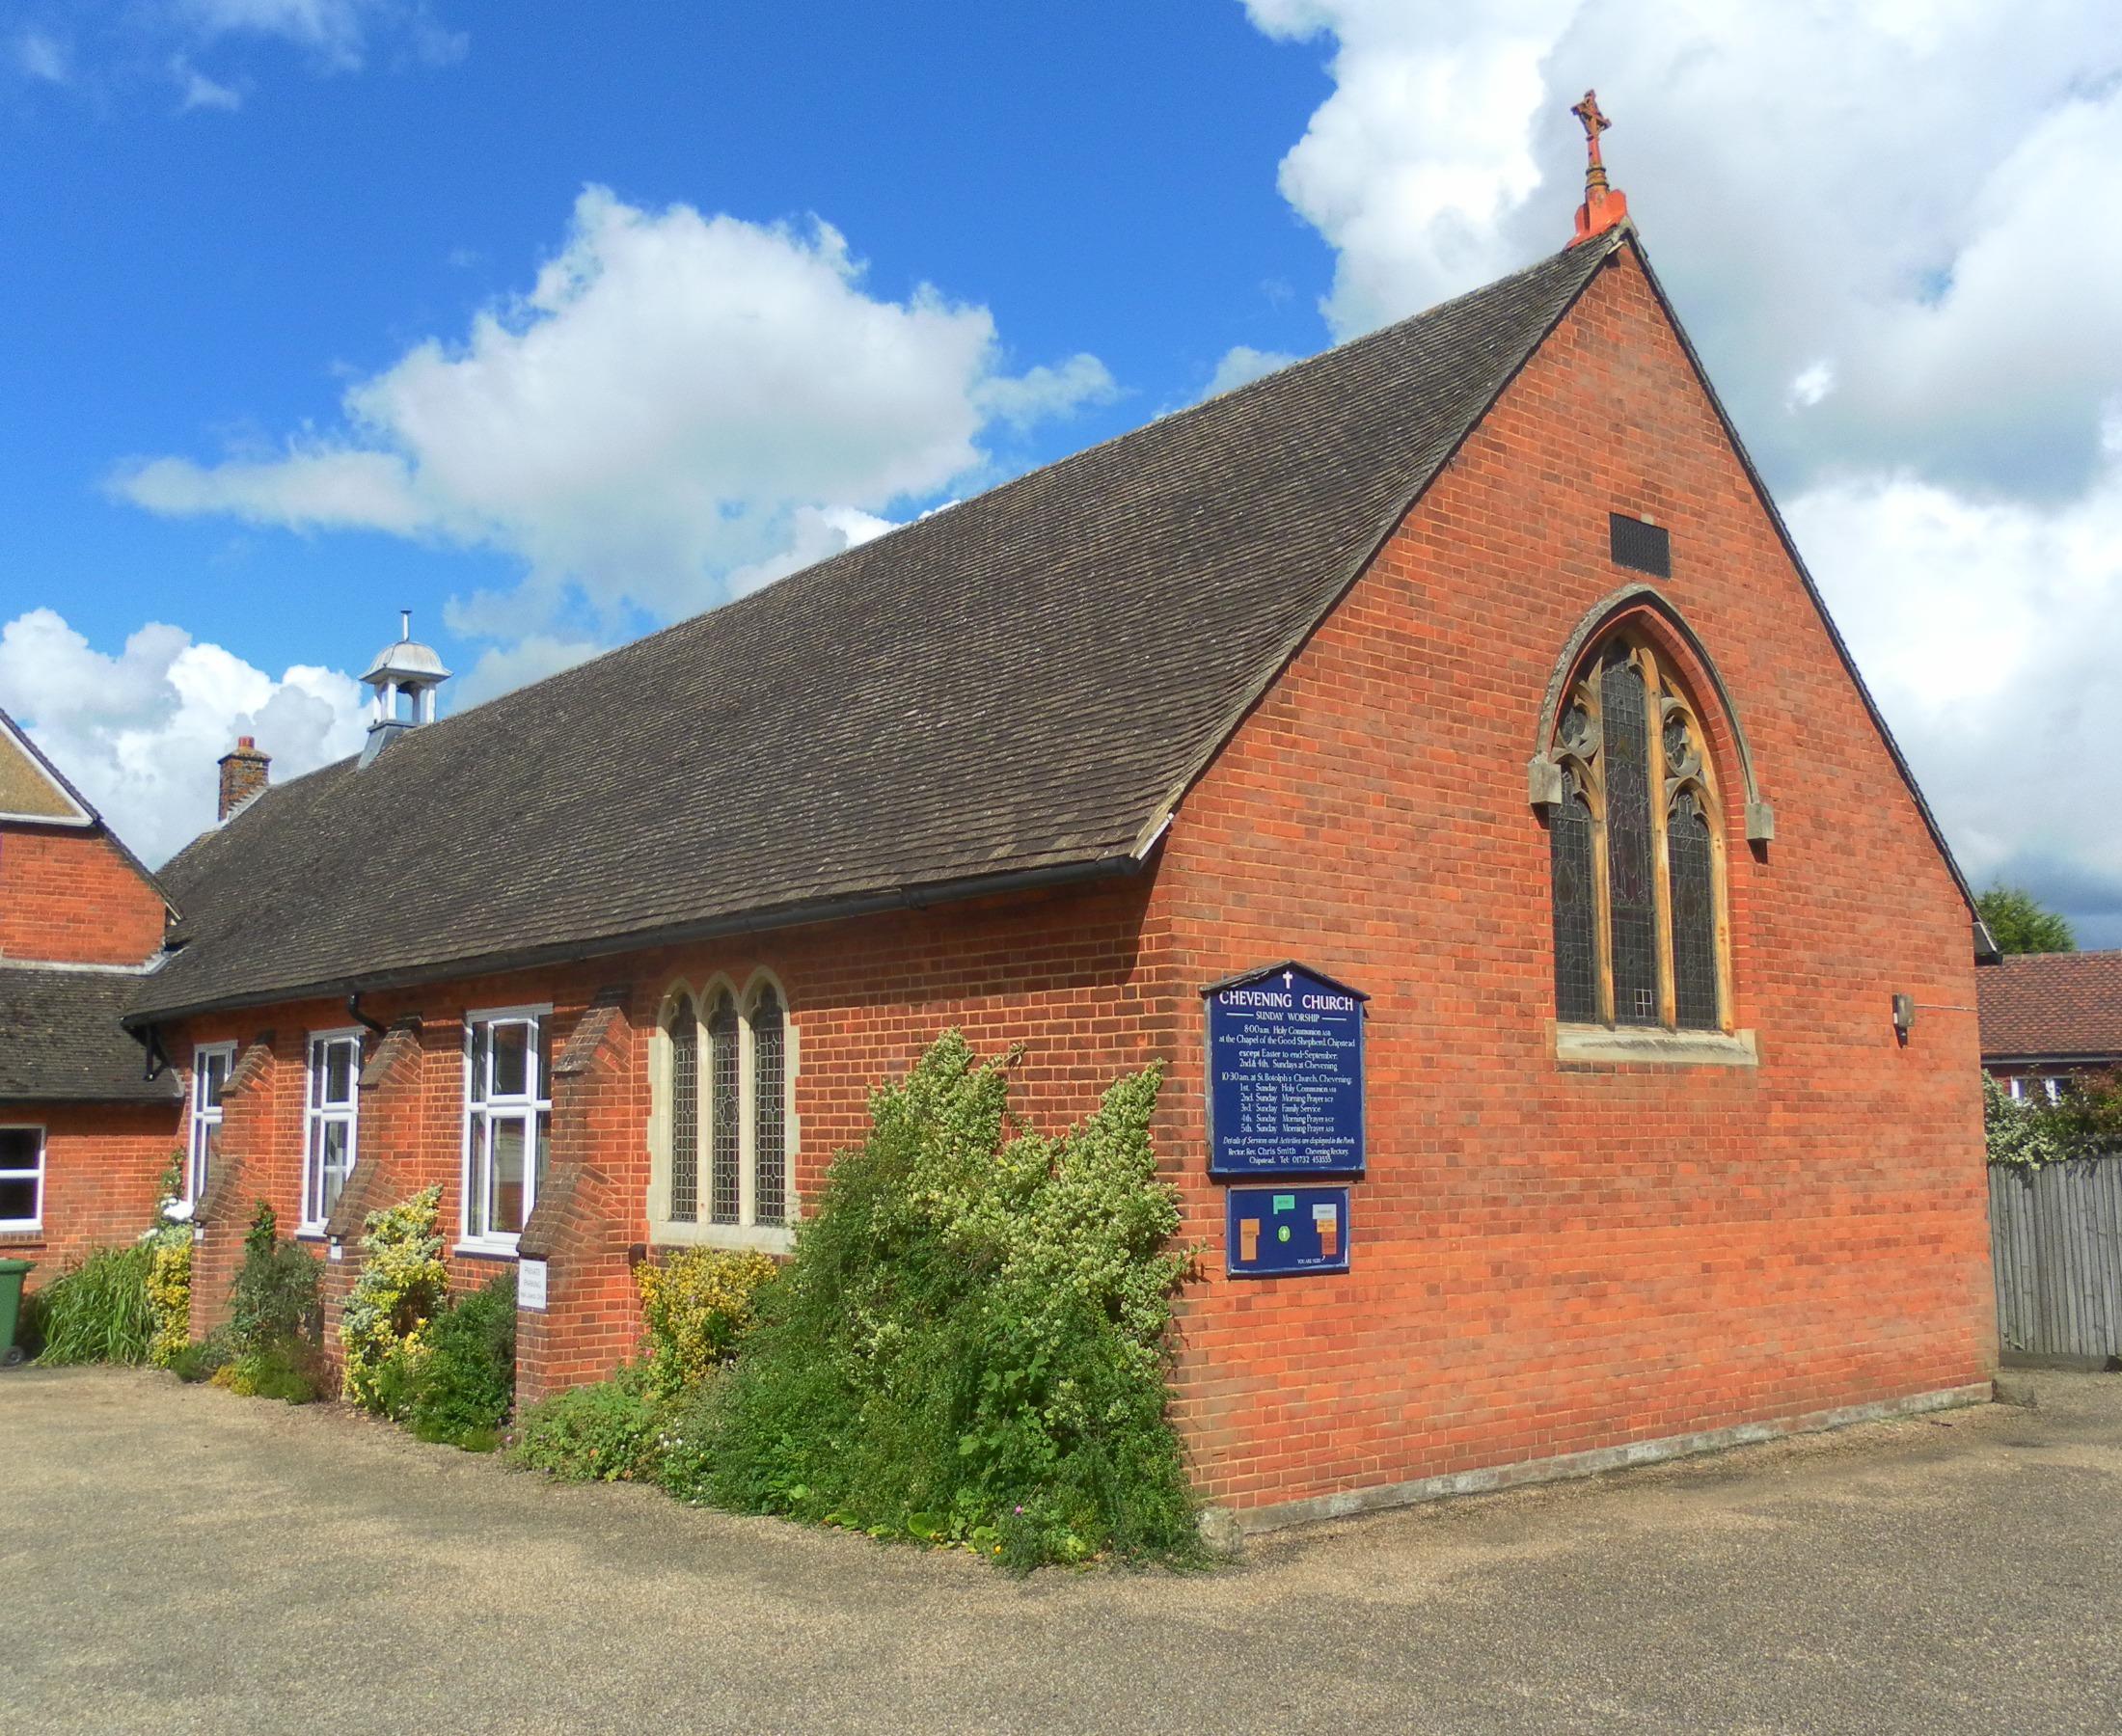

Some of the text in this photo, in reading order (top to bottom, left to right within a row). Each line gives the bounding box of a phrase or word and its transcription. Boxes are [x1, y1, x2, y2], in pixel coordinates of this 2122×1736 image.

[1219, 990, 1353, 1011] CHEVENING CHURCH
[1256, 1011, 1319, 1022] SUNDAY WORSHIP
[1273, 1025, 1287, 1036] Holy
[1289, 1026, 1321, 1036] Communion
[1225, 1034, 1236, 1043] the
[1237, 1034, 1259, 1045] Chapel
[1260, 1035, 1266, 1044] of
[1267, 1035, 1277, 1044] the
[1278, 1036, 1295, 1044] Good
[1327, 1038, 1355, 1048] Chipstead
[1238, 1049, 1260, 1059] except
[1262, 1048, 1281, 1058] Easter
[1273, 1059, 1297, 1071] Sundays
[1304, 1061, 1338, 1071] Chevening
[1255, 1082, 1277, 1093] Sunday
[1282, 1083, 1294, 1094] Holy
[1296, 1084, 1328, 1093] Communion
[1255, 1093, 1277, 1103] Sunday
[1282, 1094, 1306, 1104] Morning
[1307, 1094, 1323, 1103] Prayer
[1256, 1103, 1277, 1114] Sunday
[1282, 1103, 1299, 1114] Family
[1300, 1104, 1321, 1113] Service
[1256, 1114, 1277, 1124] Sunday
[1282, 1114, 1306, 1125] Morning
[1307, 1114, 1323, 1124] Prayer
[1256, 1124, 1277, 1134] Sunday
[1282, 1124, 1306, 1134] Morning
[1307, 1124, 1324, 1134] Prayer
[1267, 1135, 1278, 1144] and
[1258, 1147, 1275, 1155] Chris
[1277, 1146, 1296, 1154] Smith
